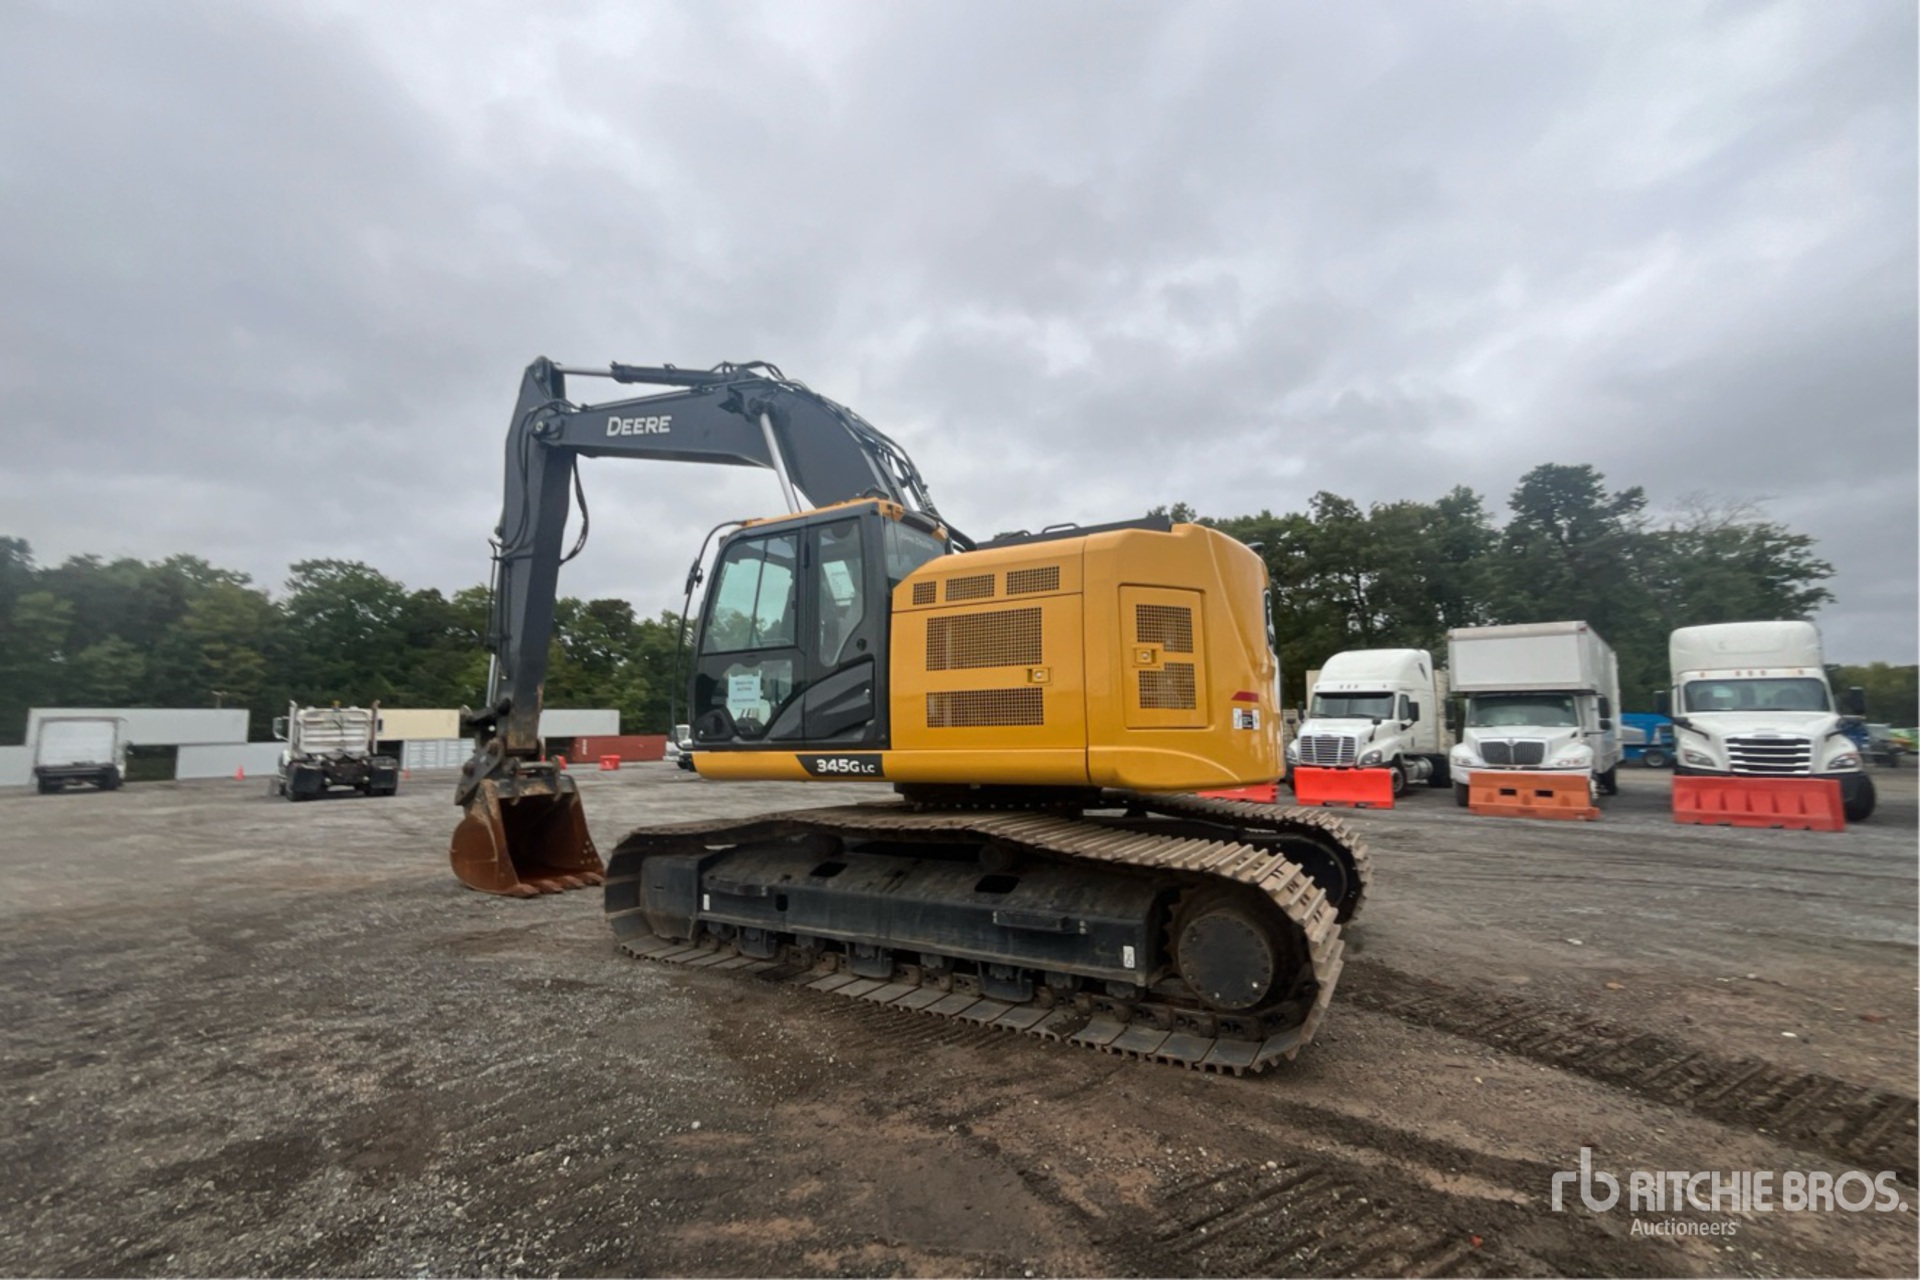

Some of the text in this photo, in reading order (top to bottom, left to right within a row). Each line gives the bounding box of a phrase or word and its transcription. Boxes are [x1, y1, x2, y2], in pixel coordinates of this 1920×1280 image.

[606, 415, 672, 437] DEERE
[816, 758, 875, 773] 345G LC
